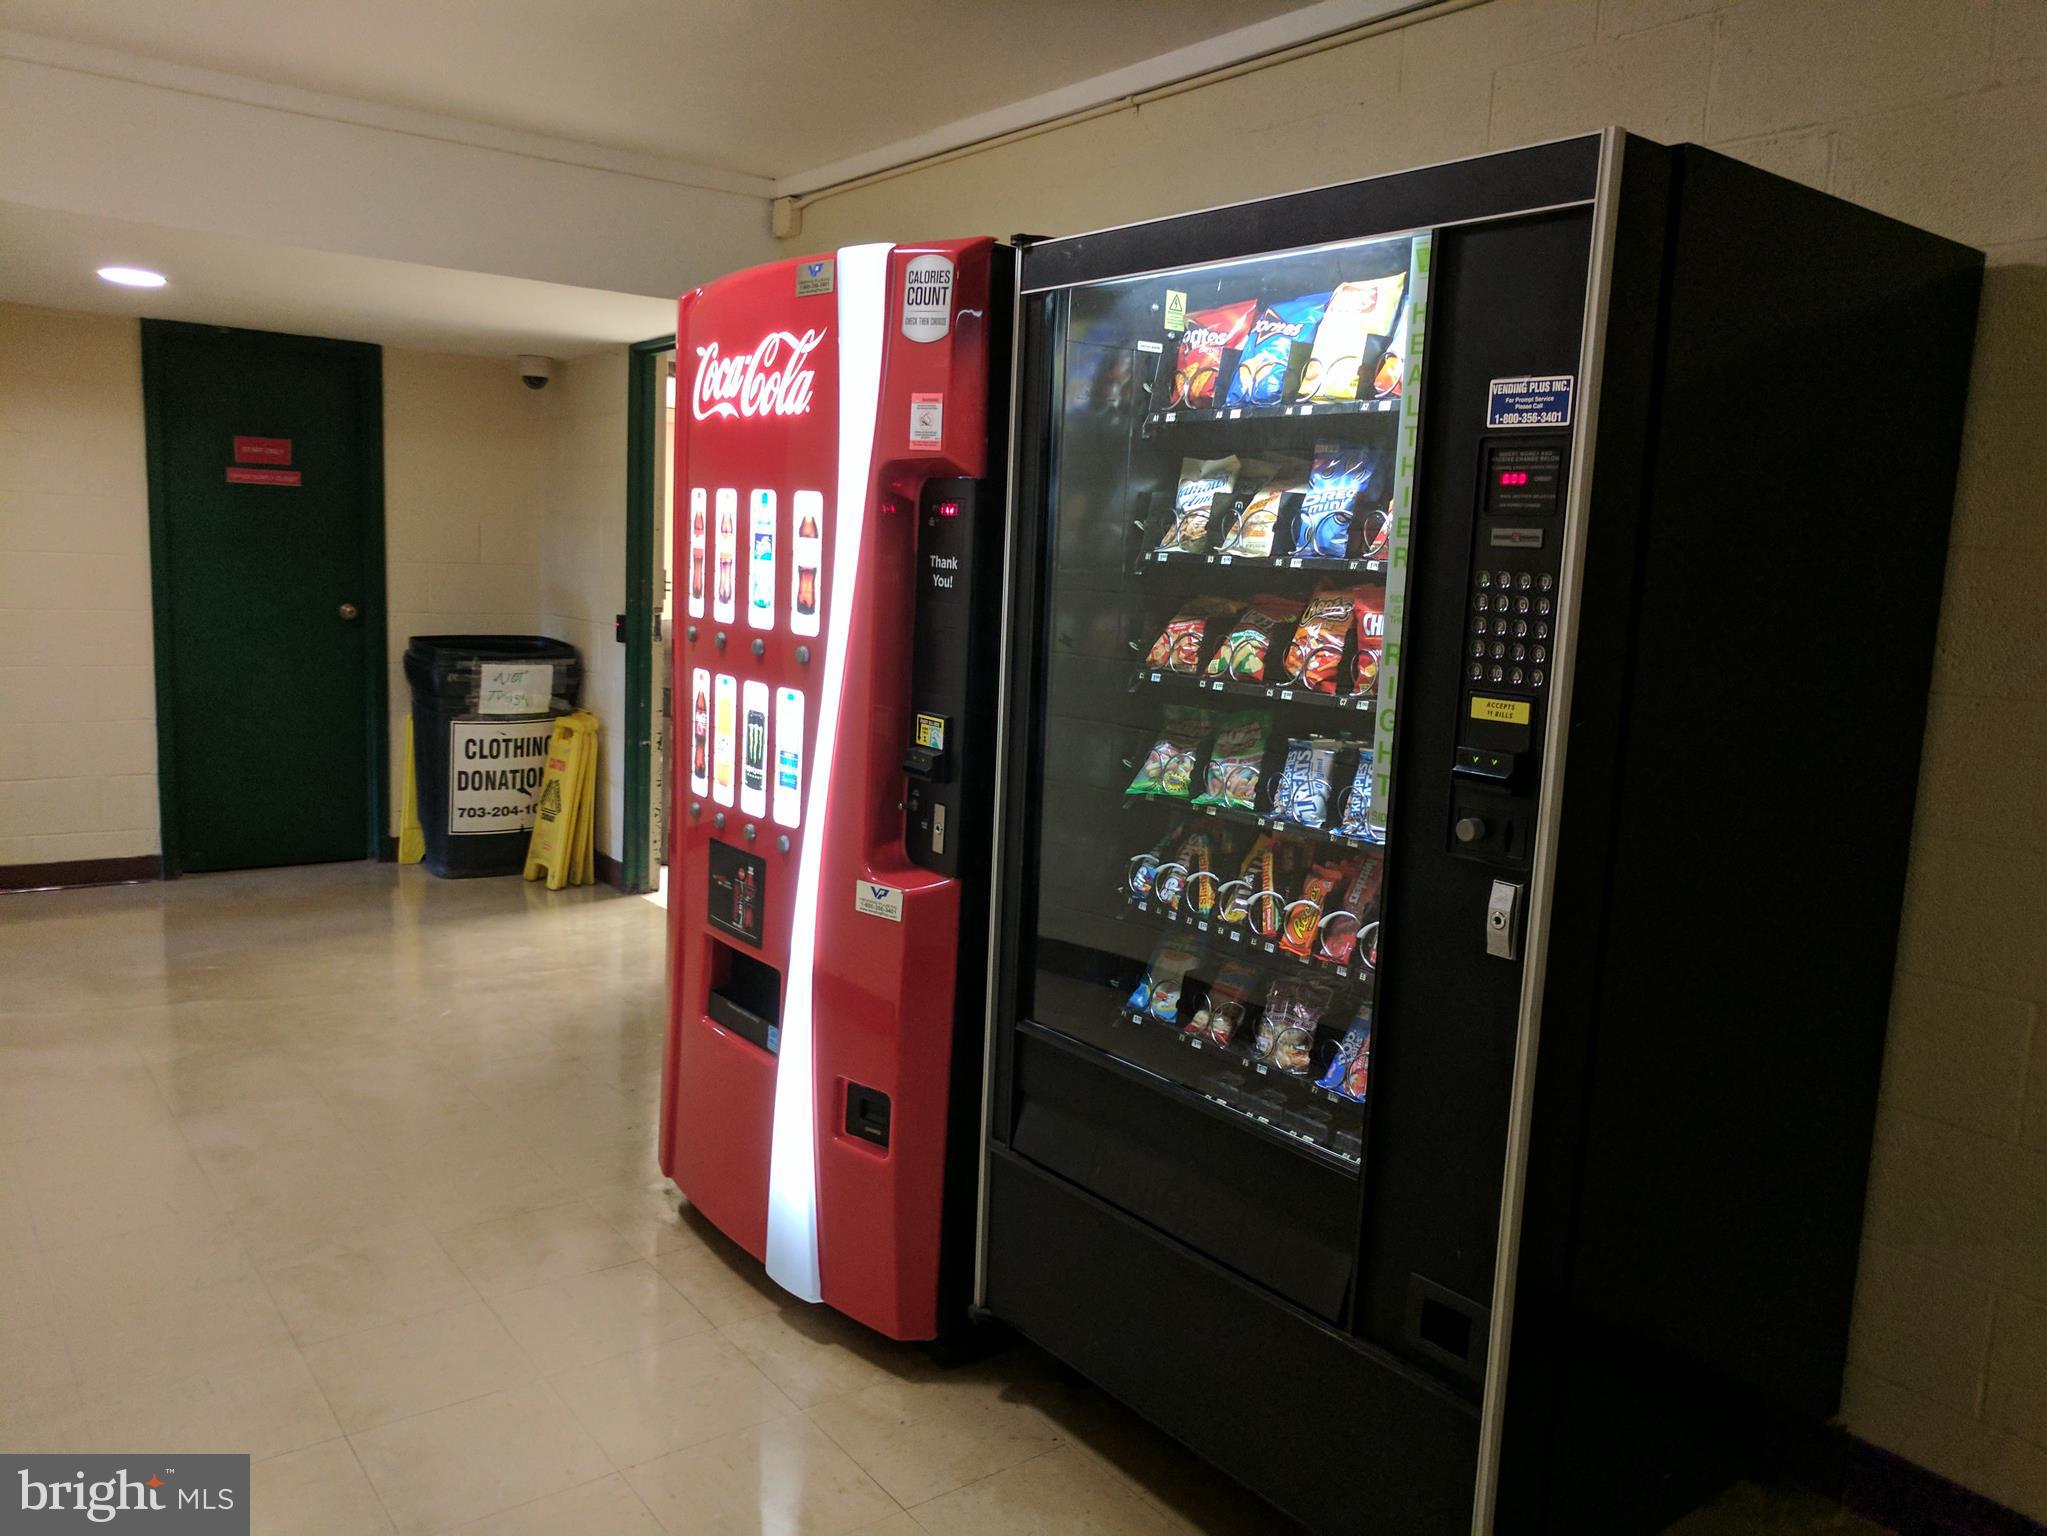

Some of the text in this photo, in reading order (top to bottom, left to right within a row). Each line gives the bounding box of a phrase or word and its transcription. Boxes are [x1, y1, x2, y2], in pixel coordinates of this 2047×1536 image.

[908, 270, 950, 284] CALORIES
[907, 286, 949, 306] COUNT
[1493, 380, 1570, 395] VENDING PLUS INC.
[1495, 411, 1562, 424] 1-800-356-3401
[930, 555, 958, 570] Thank
[933, 574, 953, 588] You!
[1487, 702, 1515, 711] ACCEPTS
[1495, 711, 1512, 719] BILLS
